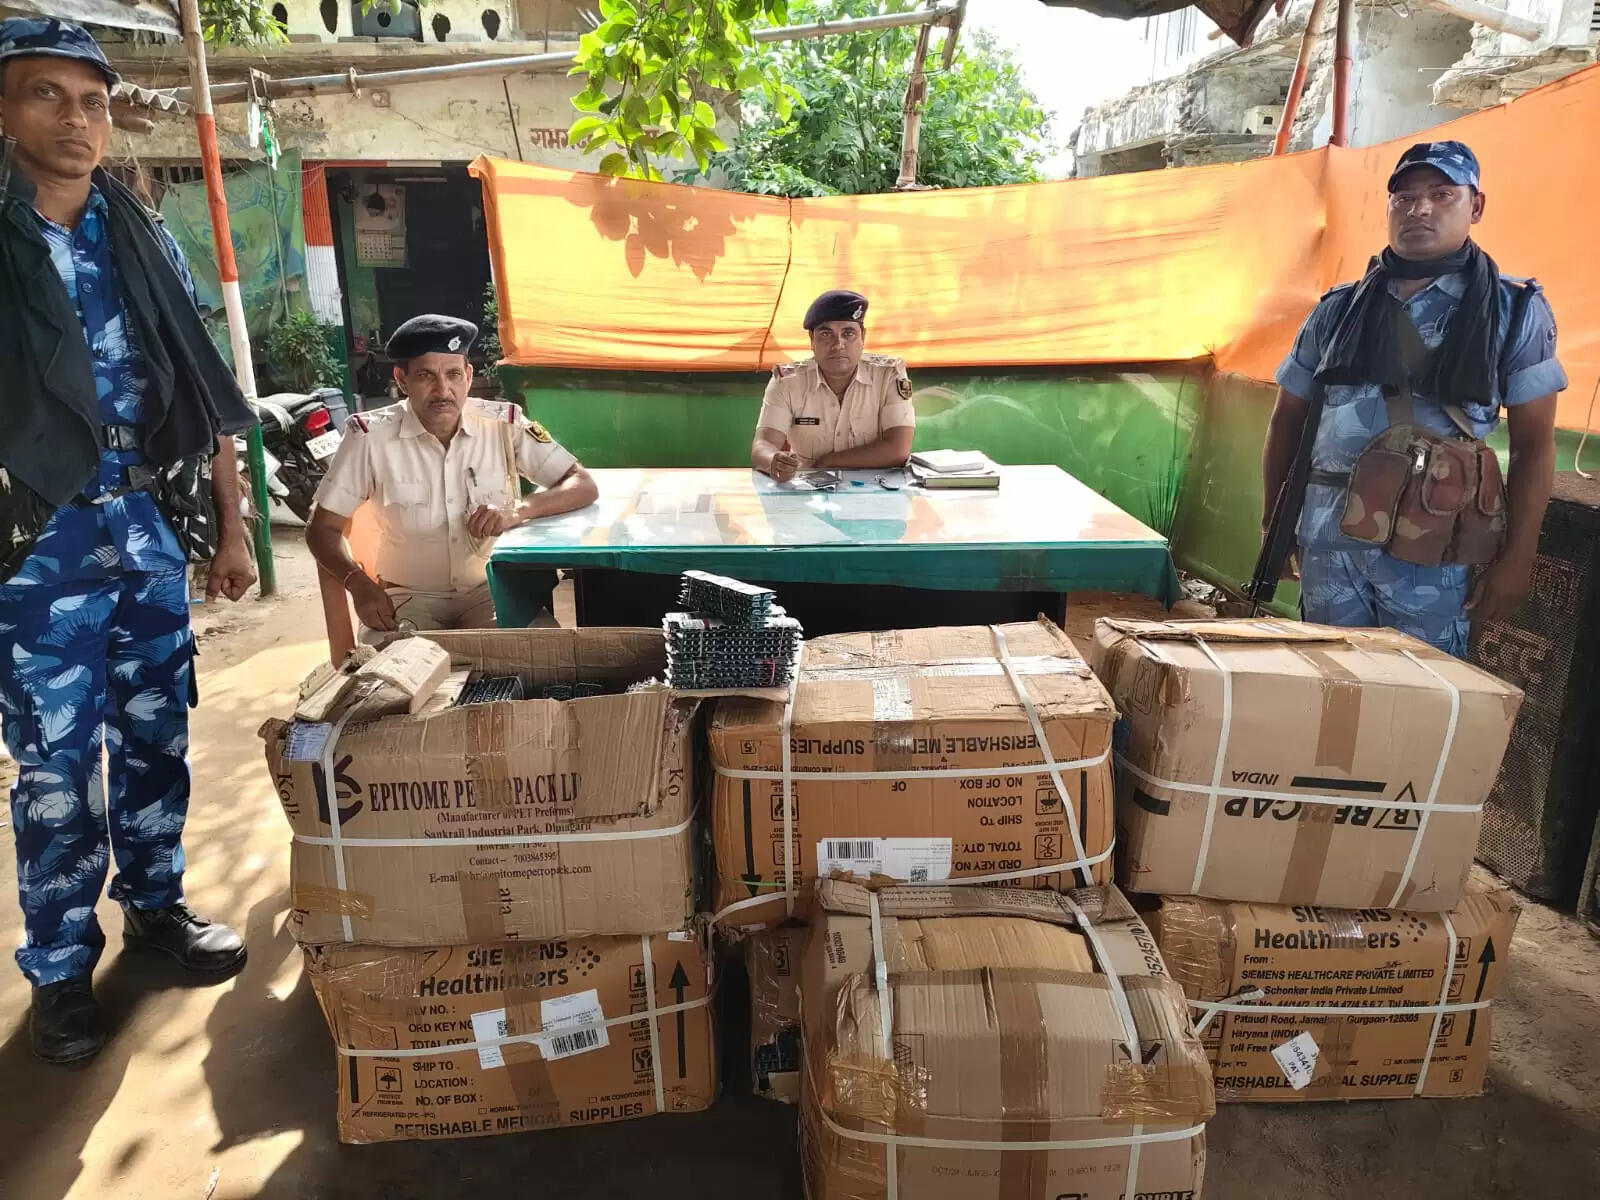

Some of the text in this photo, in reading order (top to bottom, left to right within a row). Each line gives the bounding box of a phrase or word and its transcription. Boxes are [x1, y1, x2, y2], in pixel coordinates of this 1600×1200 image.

[959, 778, 983, 790] BOX
[985, 778, 1001, 789] OF
[1231, 770, 1280, 786] INDIA
[368, 780, 450, 811] EPITOME
[453, 773, 557, 809] PEOPACK
[891, 781, 907, 792] OF
[966, 795, 1023, 809] LOCATION
[979, 814, 1023, 826] SHIP TO
[987, 841, 1023, 852] TOTAL
[468, 854, 499, 866] Contact
[971, 860, 996, 871] KEY
[998, 859, 1022, 870] ORD
[1291, 905, 1392, 923] SIENS
[467, 940, 569, 968] SIENS
[1243, 954, 1269, 965] From
[1241, 968, 1435, 981] SIEMENS HEALTHCARE PRIVATE LIMITED
[1264, 985, 1404, 996] Schenker India Private Limited
[1233, 1015, 1269, 1024] Pataudi
[408, 1021, 432, 1034] ORD
[434, 1020, 457, 1032] KEY
[1231, 1030, 1269, 1041] Haryana
[1246, 1043, 1267, 1053] Free
[412, 1060, 454, 1072] SHIP TO
[414, 1077, 469, 1089] LOCATION
[1214, 1076, 1293, 1089] ERISHABLE
[1360, 1073, 1419, 1086] SUPPLIE
[415, 1095, 434, 1106] NO.
[436, 1094, 452, 1106] OF
[454, 1092, 478, 1104] BOX
[569, 1102, 643, 1122] SUPPLIES
